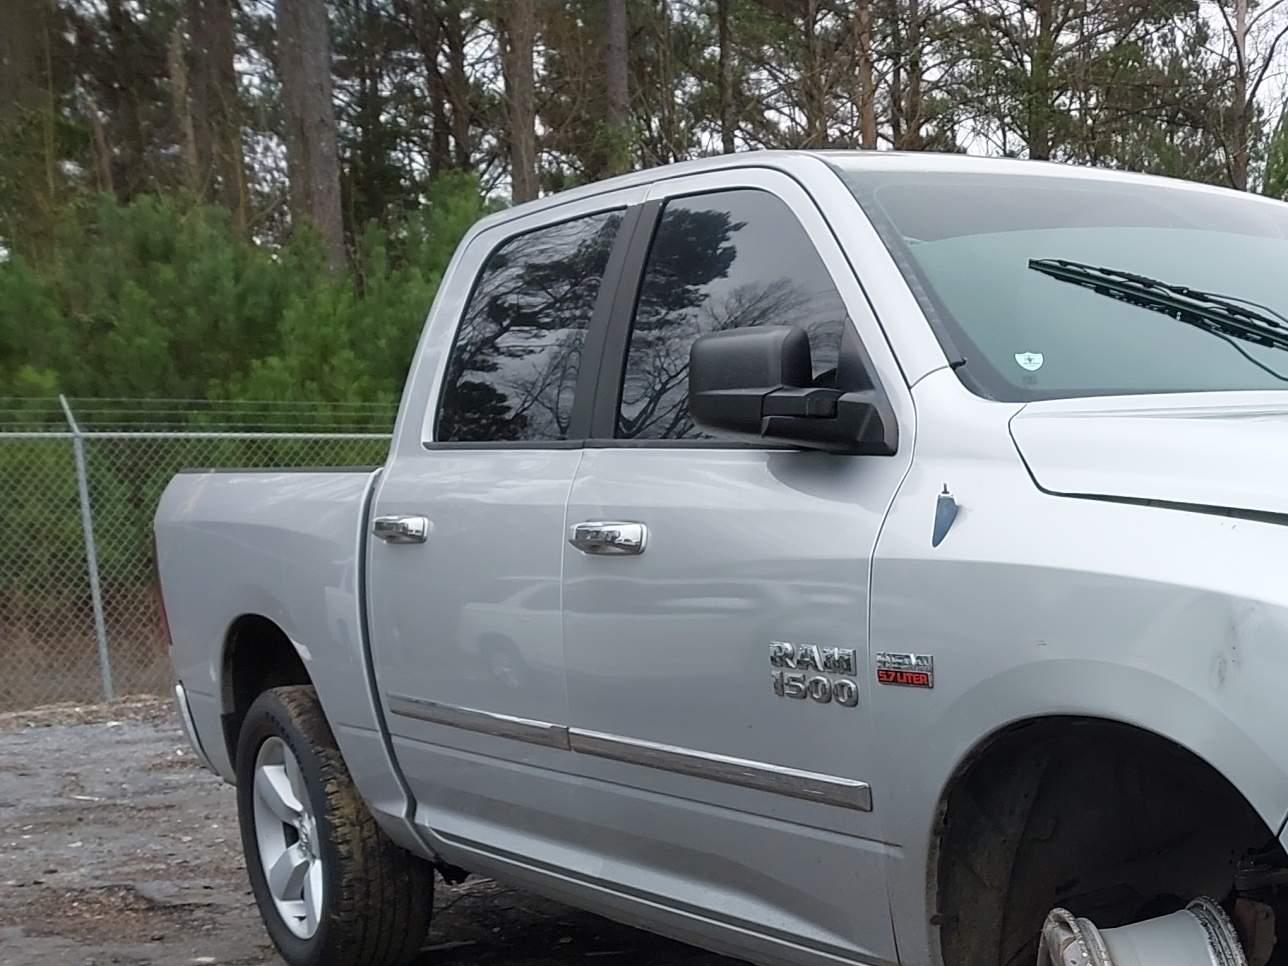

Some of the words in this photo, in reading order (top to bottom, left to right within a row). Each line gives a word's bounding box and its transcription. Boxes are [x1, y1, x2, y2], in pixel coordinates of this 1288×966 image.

[770, 641, 857, 676] RAM
[771, 670, 859, 708] 1500
[879, 671, 896, 681] 5.7
[897, 673, 929, 684] LITER
